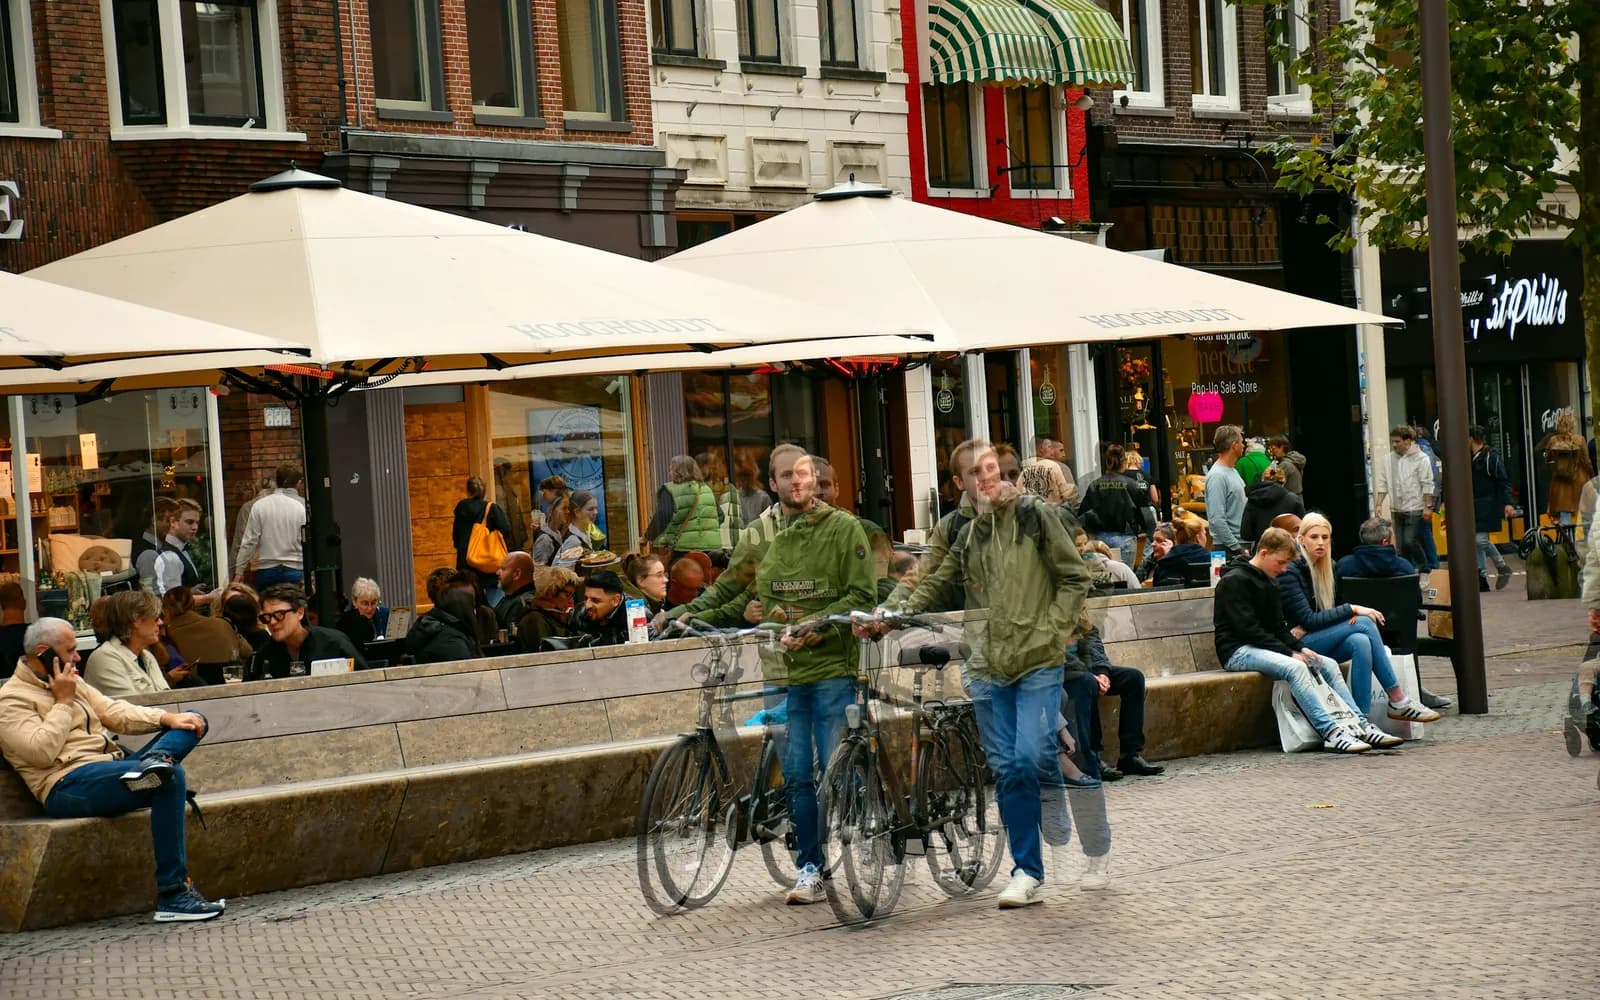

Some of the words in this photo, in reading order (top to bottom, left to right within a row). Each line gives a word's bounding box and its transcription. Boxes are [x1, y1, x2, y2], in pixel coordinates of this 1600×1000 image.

[1191, 381, 1219, 397] Pop-Up
[1220, 380, 1236, 394] Sale
[1237, 379, 1258, 393] Store
